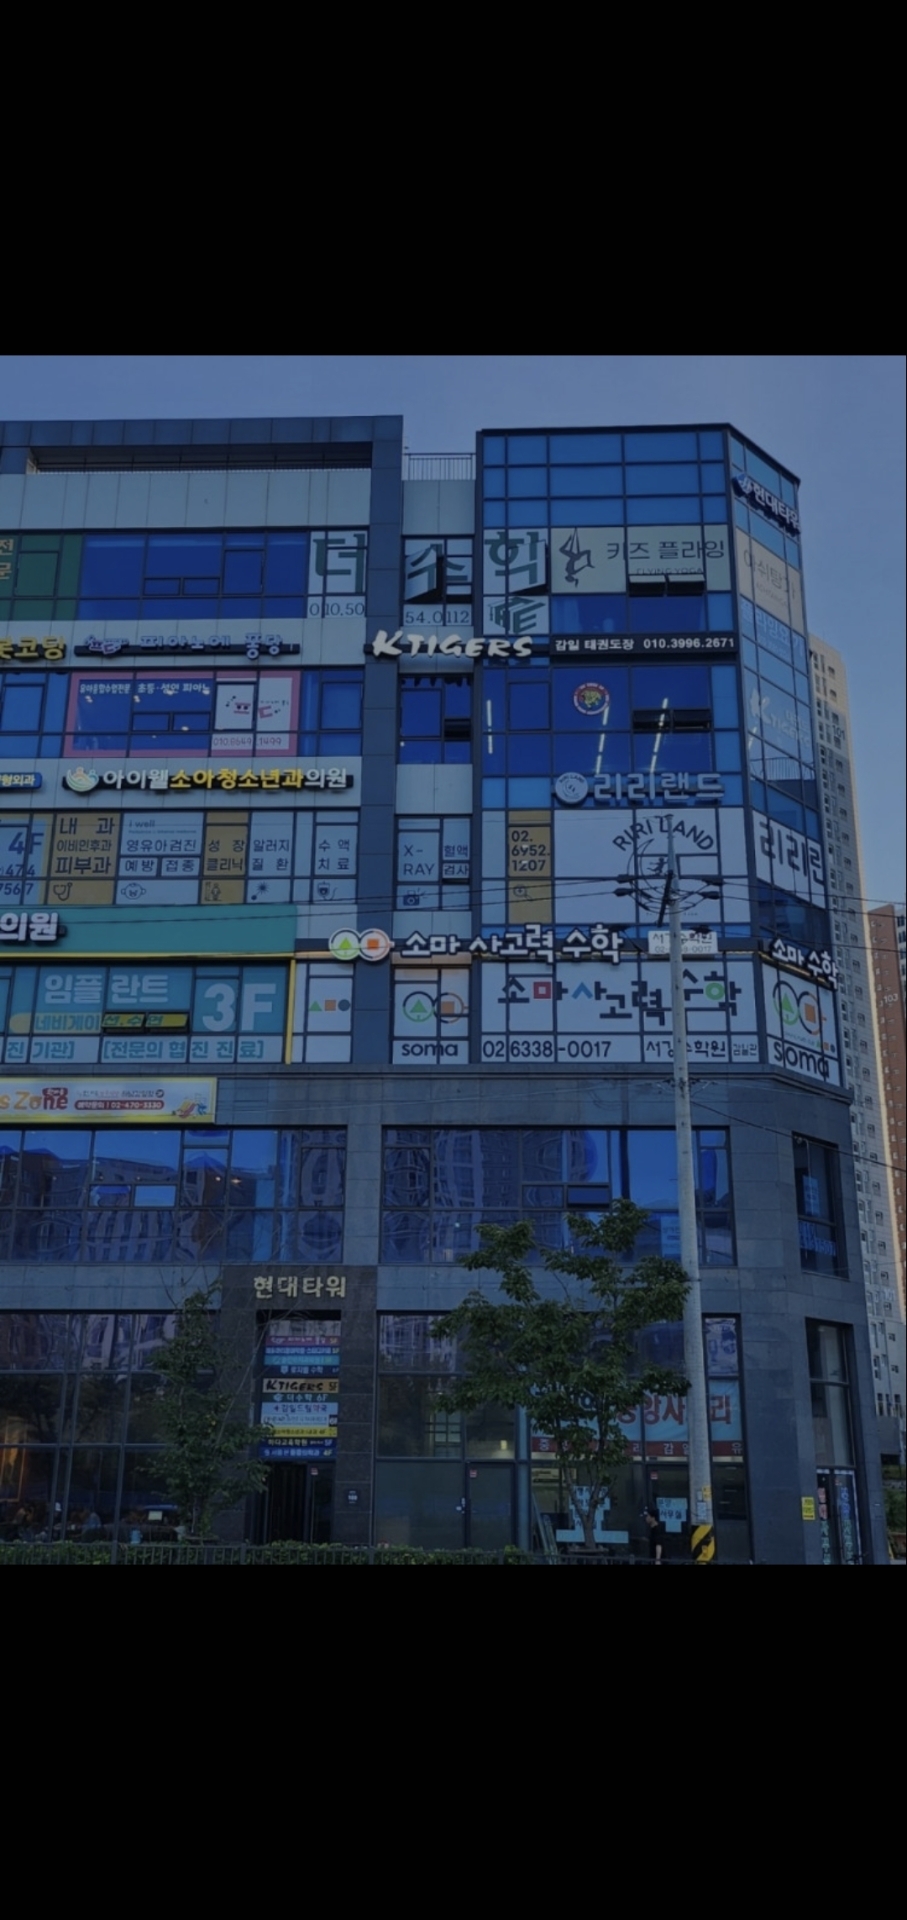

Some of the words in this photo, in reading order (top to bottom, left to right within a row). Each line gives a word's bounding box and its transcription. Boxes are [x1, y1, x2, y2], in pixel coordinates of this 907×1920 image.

[753, 482, 799, 528] 현대타워
[606, 542, 650, 560] 키즈
[659, 540, 725, 560] 플라잉
[140, 635, 231, 650] 피아노에
[244, 633, 283, 660] 퐁당
[584, 639, 634, 651] 태권도장
[643, 637, 735, 649] 010.3996.2671
[832, 724, 846, 740] 101
[0, 774, 36, 787] 형외과
[594, 772, 725, 800] 리리랜드
[8, 831, 44, 855] 4F
[612, 819, 654, 851] RIRI
[660, 816, 714, 851] LAND
[57, 839, 112, 853] 이비인후과
[126, 839, 197, 853] 영유아검진
[443, 844, 468, 858] 혈액
[55, 857, 112, 875] 피부과
[206, 858, 243, 871] 클리닉
[403, 863, 435, 876] RAY
[443, 864, 469, 876] 검사
[511, 859, 546, 872] 1207
[0, 912, 59, 942] 의원
[401, 930, 461, 957] 소마
[469, 923, 553, 963] 사고력
[562, 924, 623, 963] 수학
[772, 938, 803, 966] 소마
[807, 950, 839, 990] 수학
[202, 982, 277, 1033] 3F
[498, 976, 568, 1004] 소마
[571, 981, 665, 1026] 사고력
[104, 1040, 163, 1060] [전문의
[401, 1042, 459, 1057] soma
[773, 1041, 830, 1078] soma
[253, 1275, 346, 1299] 현대타워
[617, 1394, 731, 1426] 앙사리
